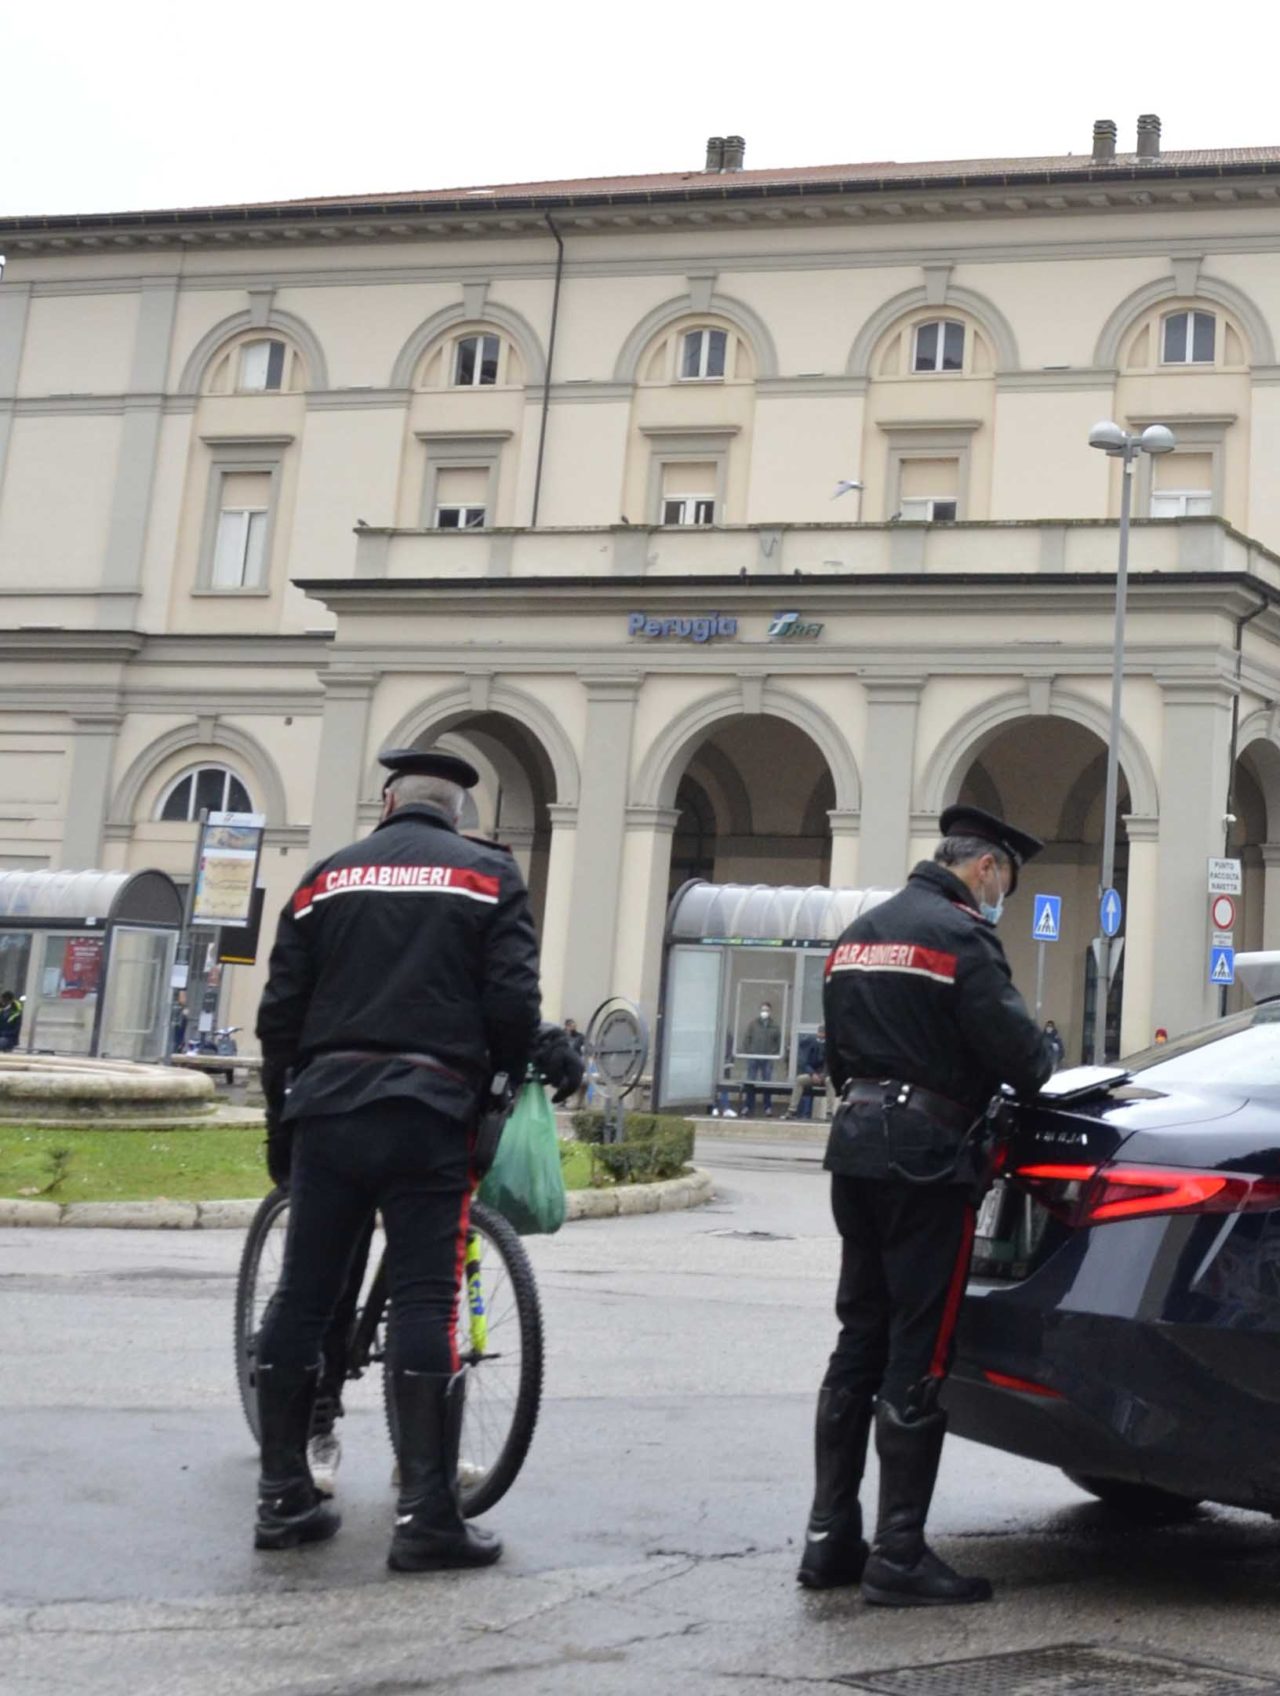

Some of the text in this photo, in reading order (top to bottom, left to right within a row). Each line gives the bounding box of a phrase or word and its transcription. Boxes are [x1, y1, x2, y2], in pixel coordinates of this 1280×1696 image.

[628, 611, 738, 643] Perugia
[1214, 861, 1235, 870] PUNTO
[325, 866, 452, 890] CARABINIERI
[1210, 871, 1239, 881] RACCOLTA
[1211, 882, 1238, 891] NAVETTA
